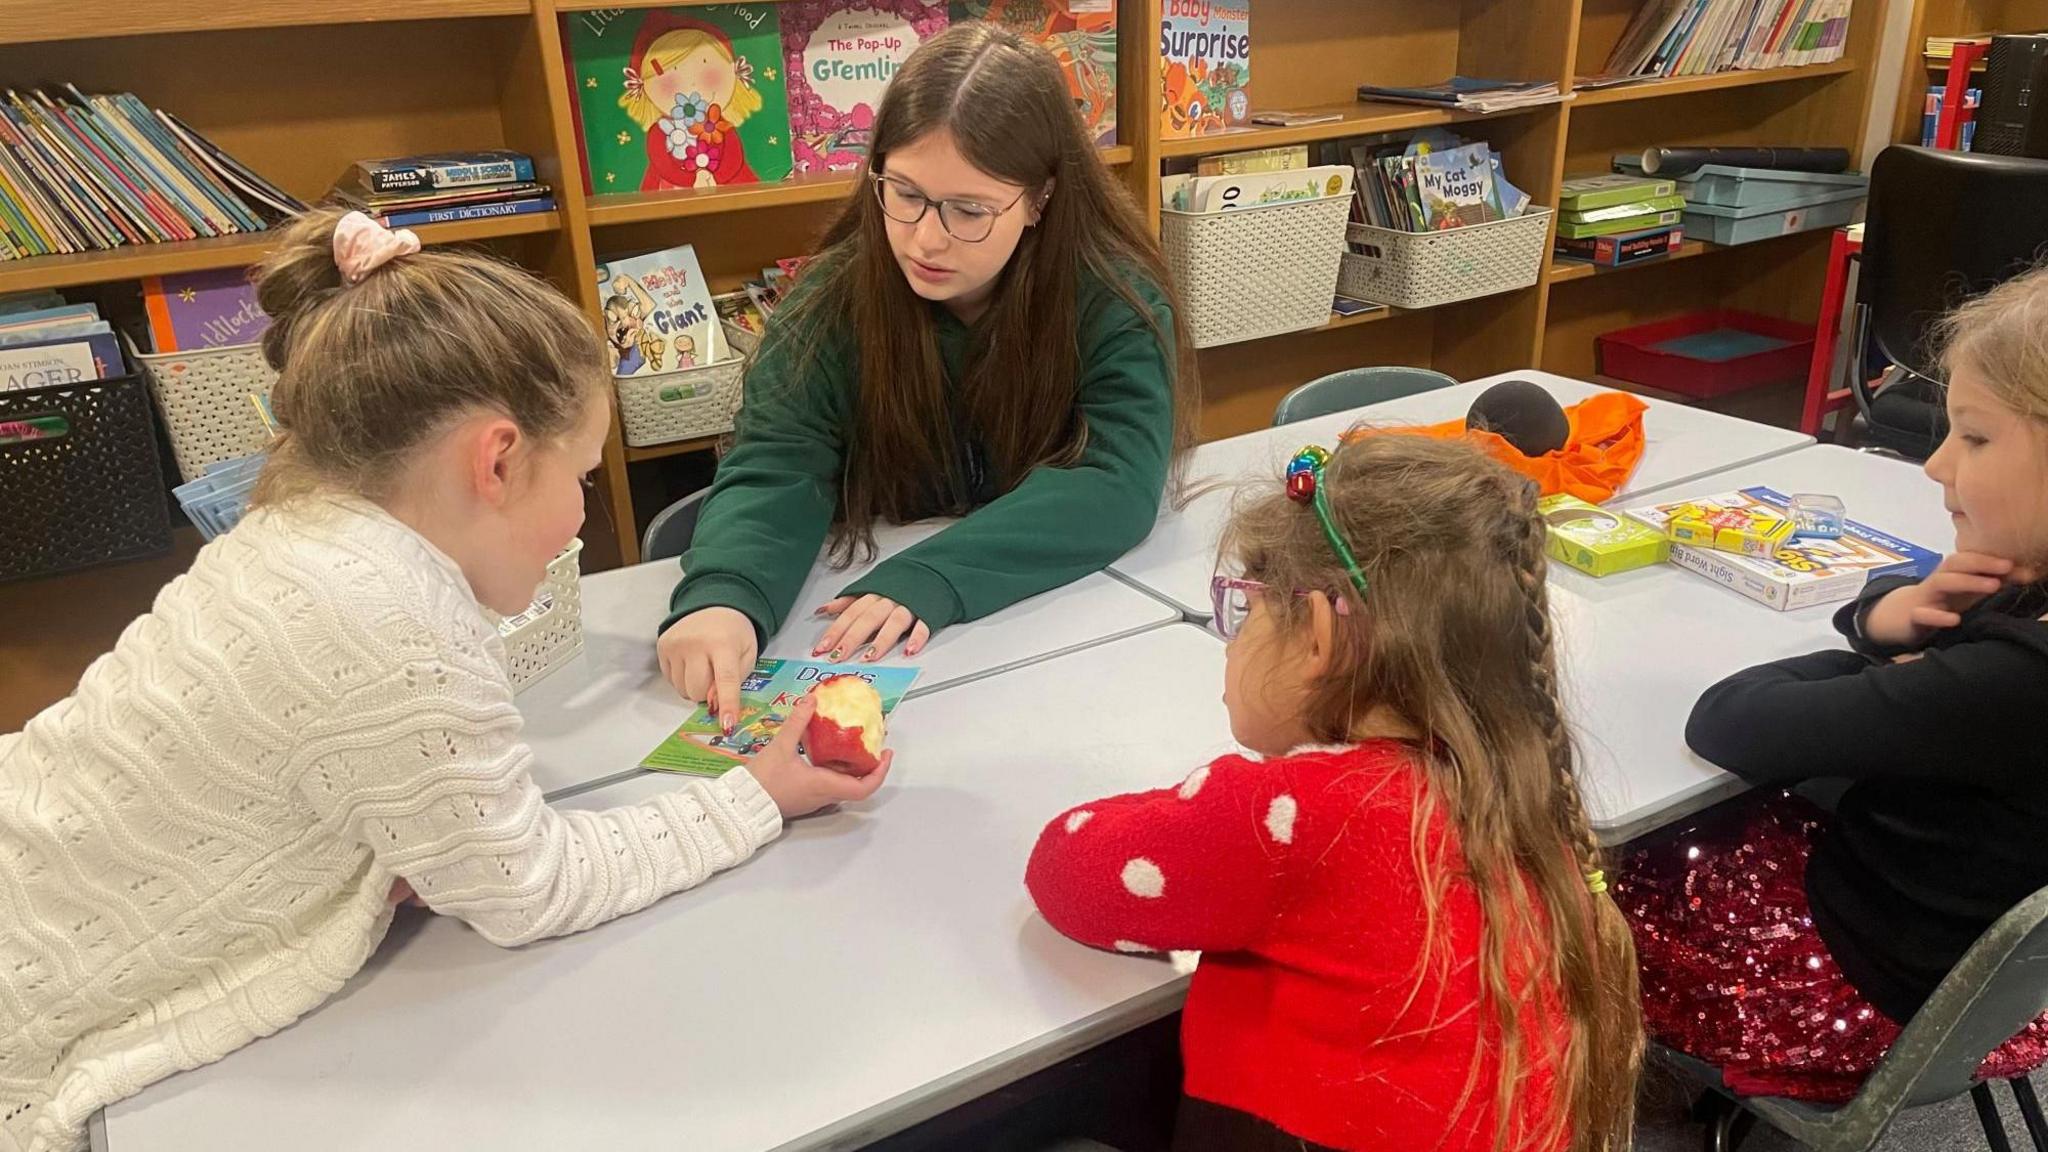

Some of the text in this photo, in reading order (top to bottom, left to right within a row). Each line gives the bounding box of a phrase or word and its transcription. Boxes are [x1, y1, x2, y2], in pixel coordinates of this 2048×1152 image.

[1170, 0, 1210, 26] Baby
[828, 37, 901, 52] The Pop-Up
[1160, 21, 1249, 68] Surprise
[381, 172, 416, 182] JAMES
[480, 163, 513, 174] SCHOOL
[381, 180, 420, 188] PATTERSON
[1424, 174, 1442, 190] My
[1446, 168, 1466, 183] Cat
[1443, 180, 1484, 198] Moggy
[429, 204, 518, 222] FIRST DICTIONARY
[654, 302, 708, 334] Giant
[22, 358, 64, 369] STIMSON
[1685, 552, 1708, 571] Word
[1710, 564, 1733, 583] Sight
